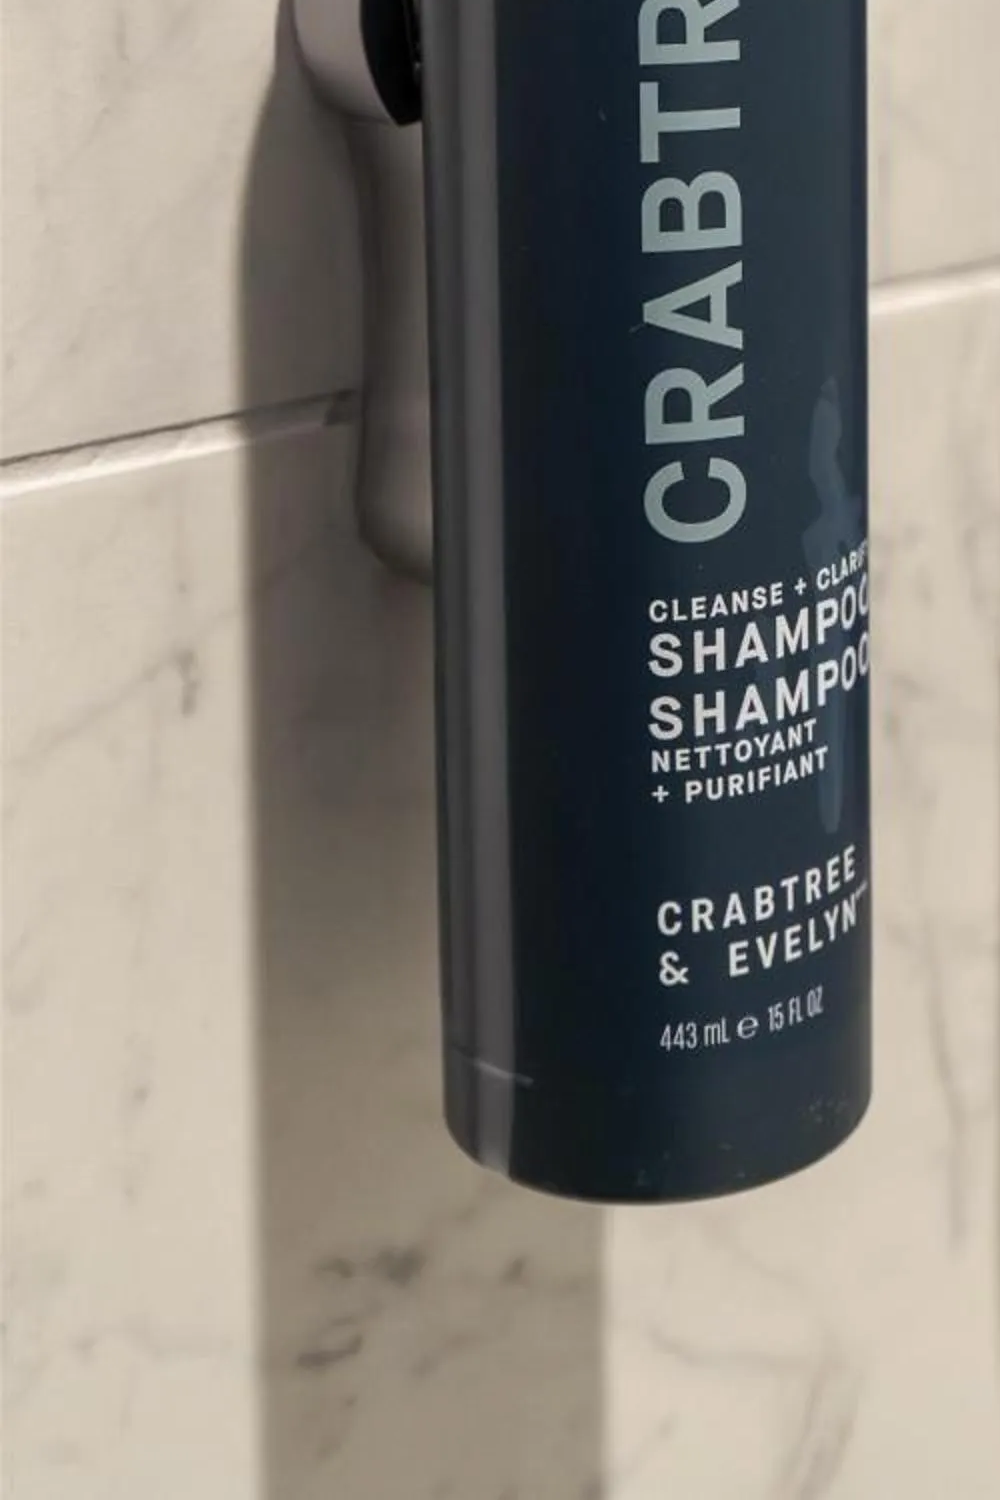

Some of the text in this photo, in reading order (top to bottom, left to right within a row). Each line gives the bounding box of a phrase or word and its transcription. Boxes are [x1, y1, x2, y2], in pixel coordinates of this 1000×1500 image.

[649, 582, 783, 623] CLEANSE
[652, 718, 817, 773] NETTOYANT
[652, 746, 828, 804] + PURIFIANT
[657, 844, 856, 936] CRABTREE
[659, 951, 689, 986] &
[660, 1021, 698, 1050] 443
[704, 1016, 730, 1047] mL
[768, 1002, 784, 1032] 15
